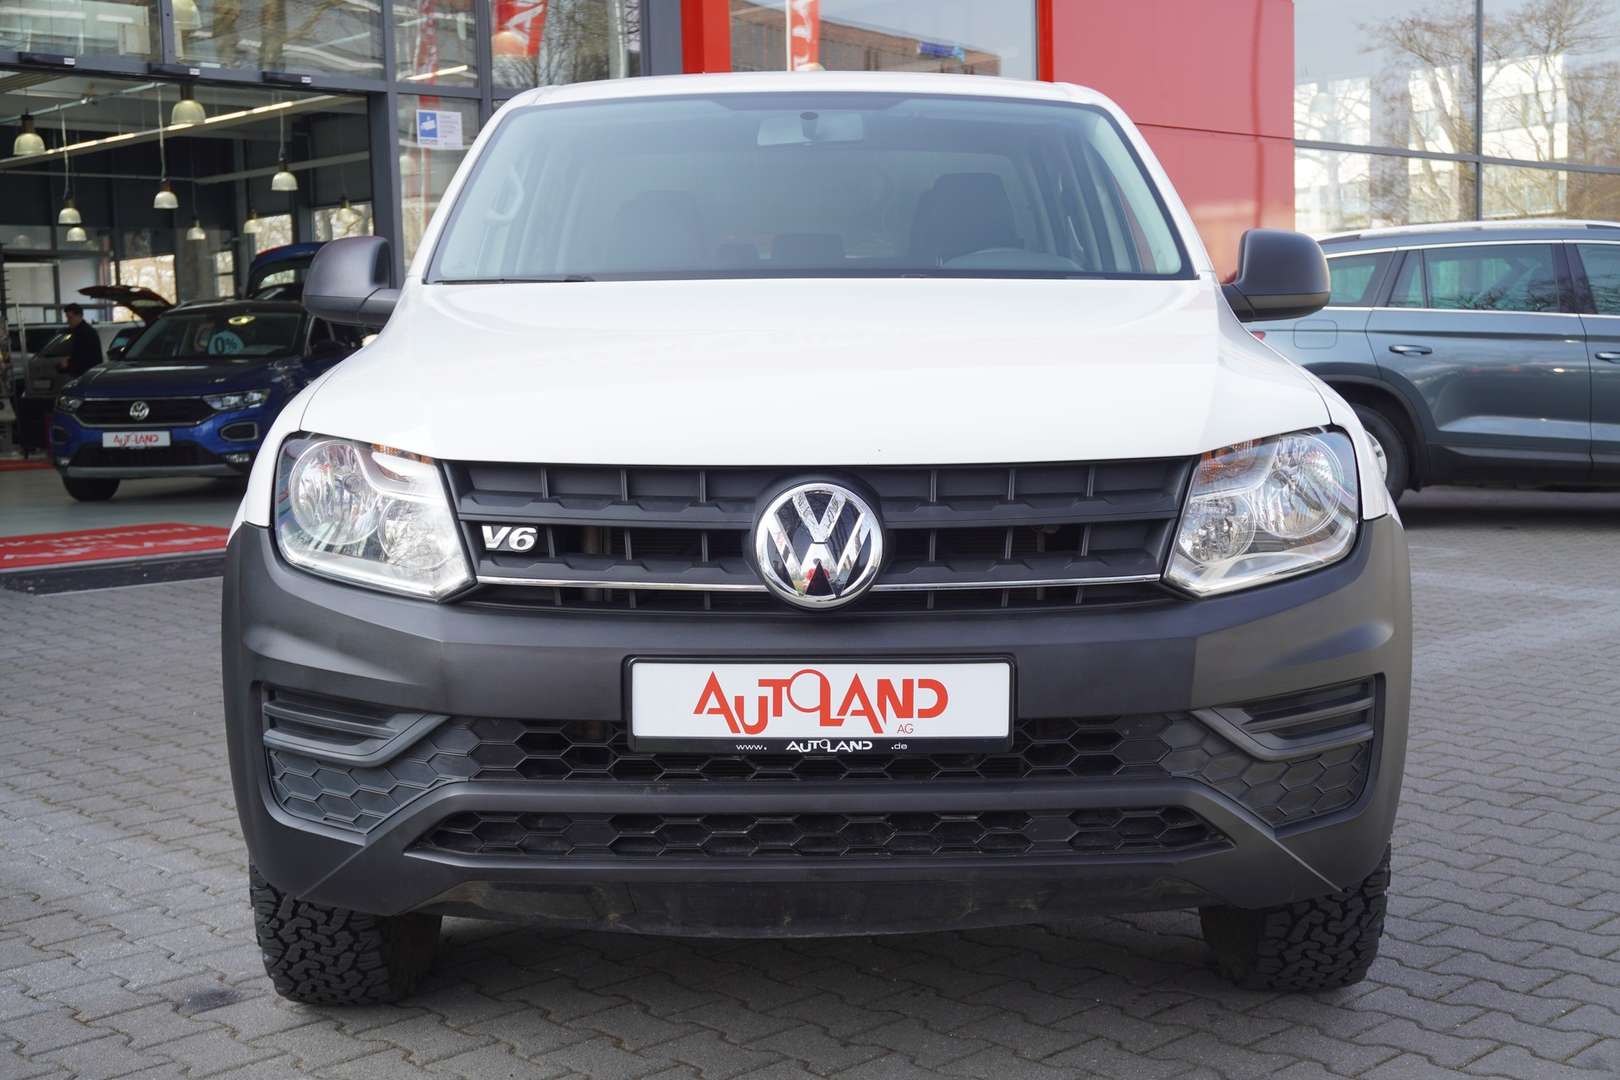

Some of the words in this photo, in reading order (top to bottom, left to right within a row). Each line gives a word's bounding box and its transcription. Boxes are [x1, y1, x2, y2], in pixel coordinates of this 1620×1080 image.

[481, 525, 537, 551] V6
[693, 669, 948, 735] AUTOLAND
[897, 723, 914, 735] AG
[736, 743, 767, 751] www.
[785, 739, 873, 753] AUTOLAND
